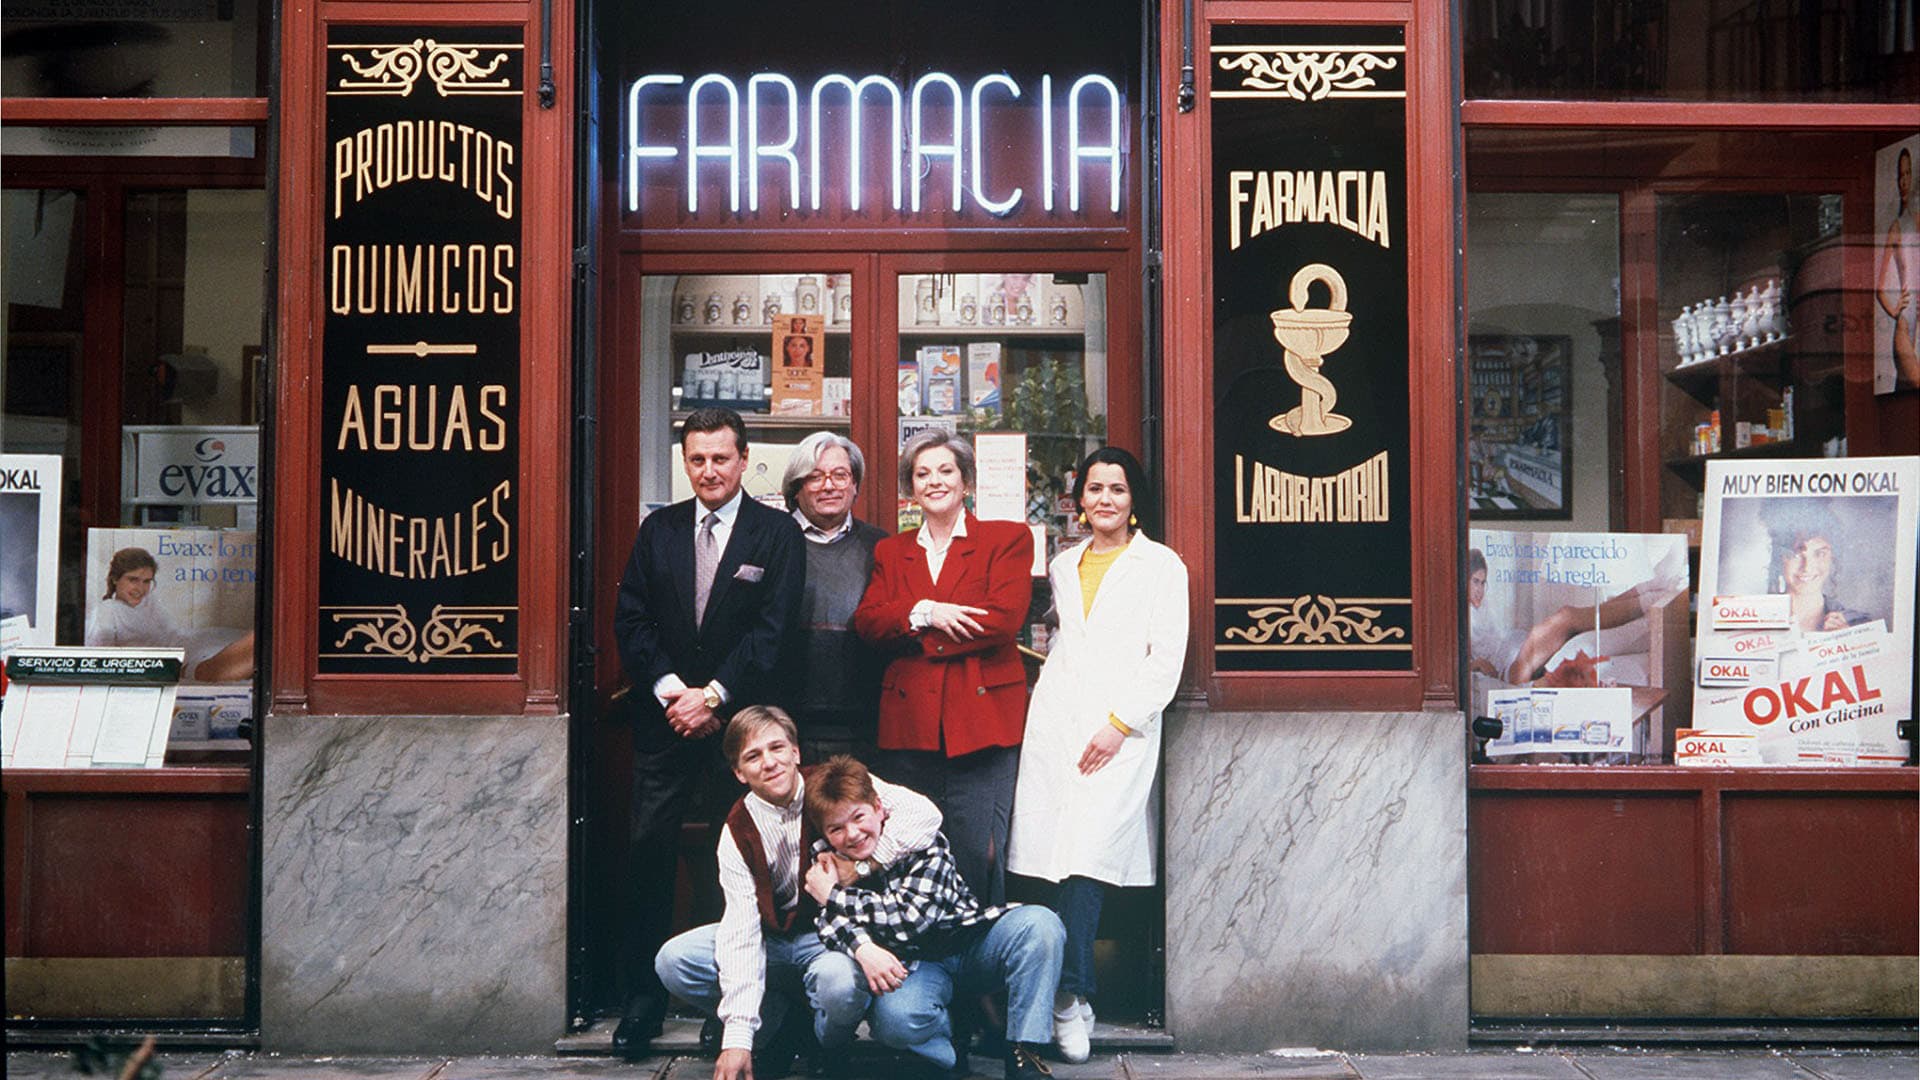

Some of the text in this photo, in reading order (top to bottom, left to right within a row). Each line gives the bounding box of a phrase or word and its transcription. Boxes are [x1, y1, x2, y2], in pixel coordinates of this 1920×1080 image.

[628, 72, 1122, 216] FARMACIA
[335, 120, 514, 219] PRODUCTOS
[1230, 171, 1390, 250] FARMACIA
[332, 245, 514, 315] QUIMICOS
[337, 384, 506, 450] AGUAS
[159, 464, 256, 498] evax
[1235, 450, 1390, 523] LABORATORIO
[1722, 472, 1900, 495] MUY BIEN CON OKAL
[331, 477, 510, 579] MINERALES
[158, 535, 213, 557] Evax:
[217, 535, 237, 557] lo
[1552, 539, 1628, 564] parecido
[175, 566, 256, 583] a no ten
[1547, 563, 1560, 584] la
[1565, 563, 1611, 588] regla.
[1719, 606, 1759, 618] OKAL
[1734, 634, 1775, 653] OKAL
[1818, 643, 1850, 658] OKAL
[17, 658, 164, 669] SERVICIO DE URGENCIA
[1710, 665, 1750, 677] OKAL
[1743, 664, 1882, 726] OKAL
[1789, 702, 1884, 734] Con Glicina
[1685, 740, 1727, 754] OKAL
